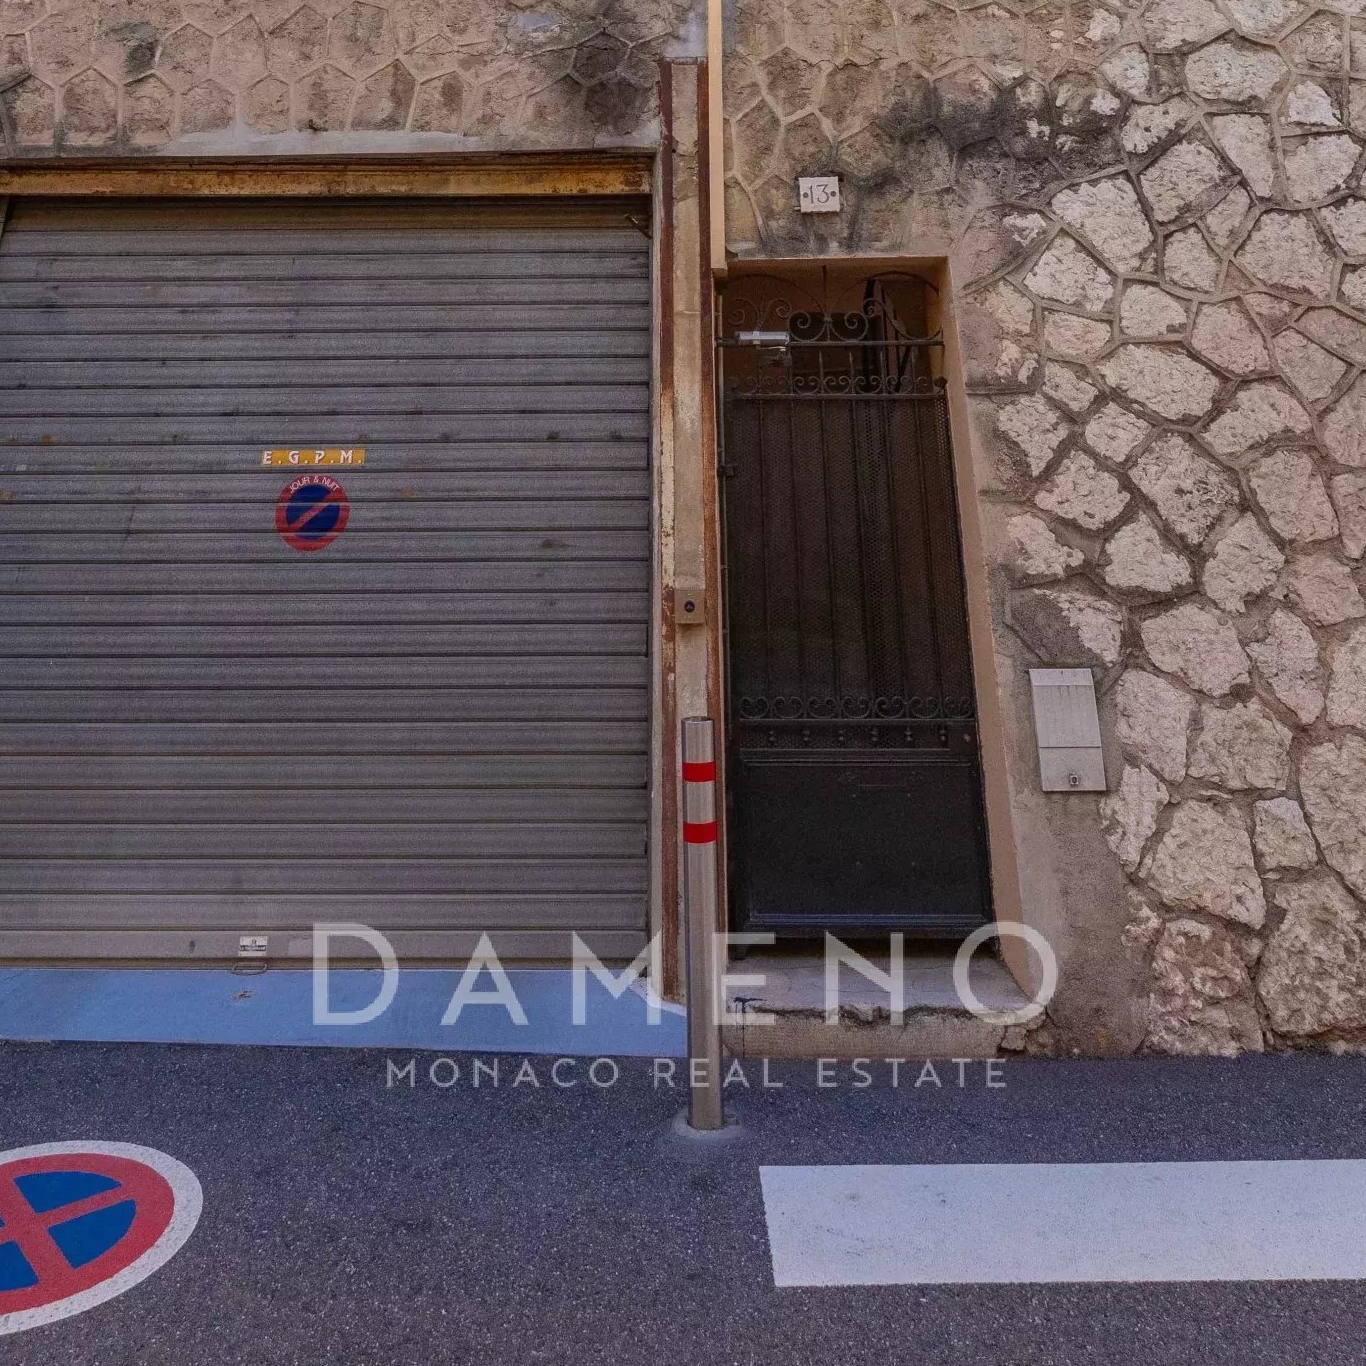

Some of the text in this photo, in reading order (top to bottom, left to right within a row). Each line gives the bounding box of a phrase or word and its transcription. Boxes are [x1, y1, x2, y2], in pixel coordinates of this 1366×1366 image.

[808, 183, 830, 205] 13
[289, 475, 341, 494] JOUR & NUIT
